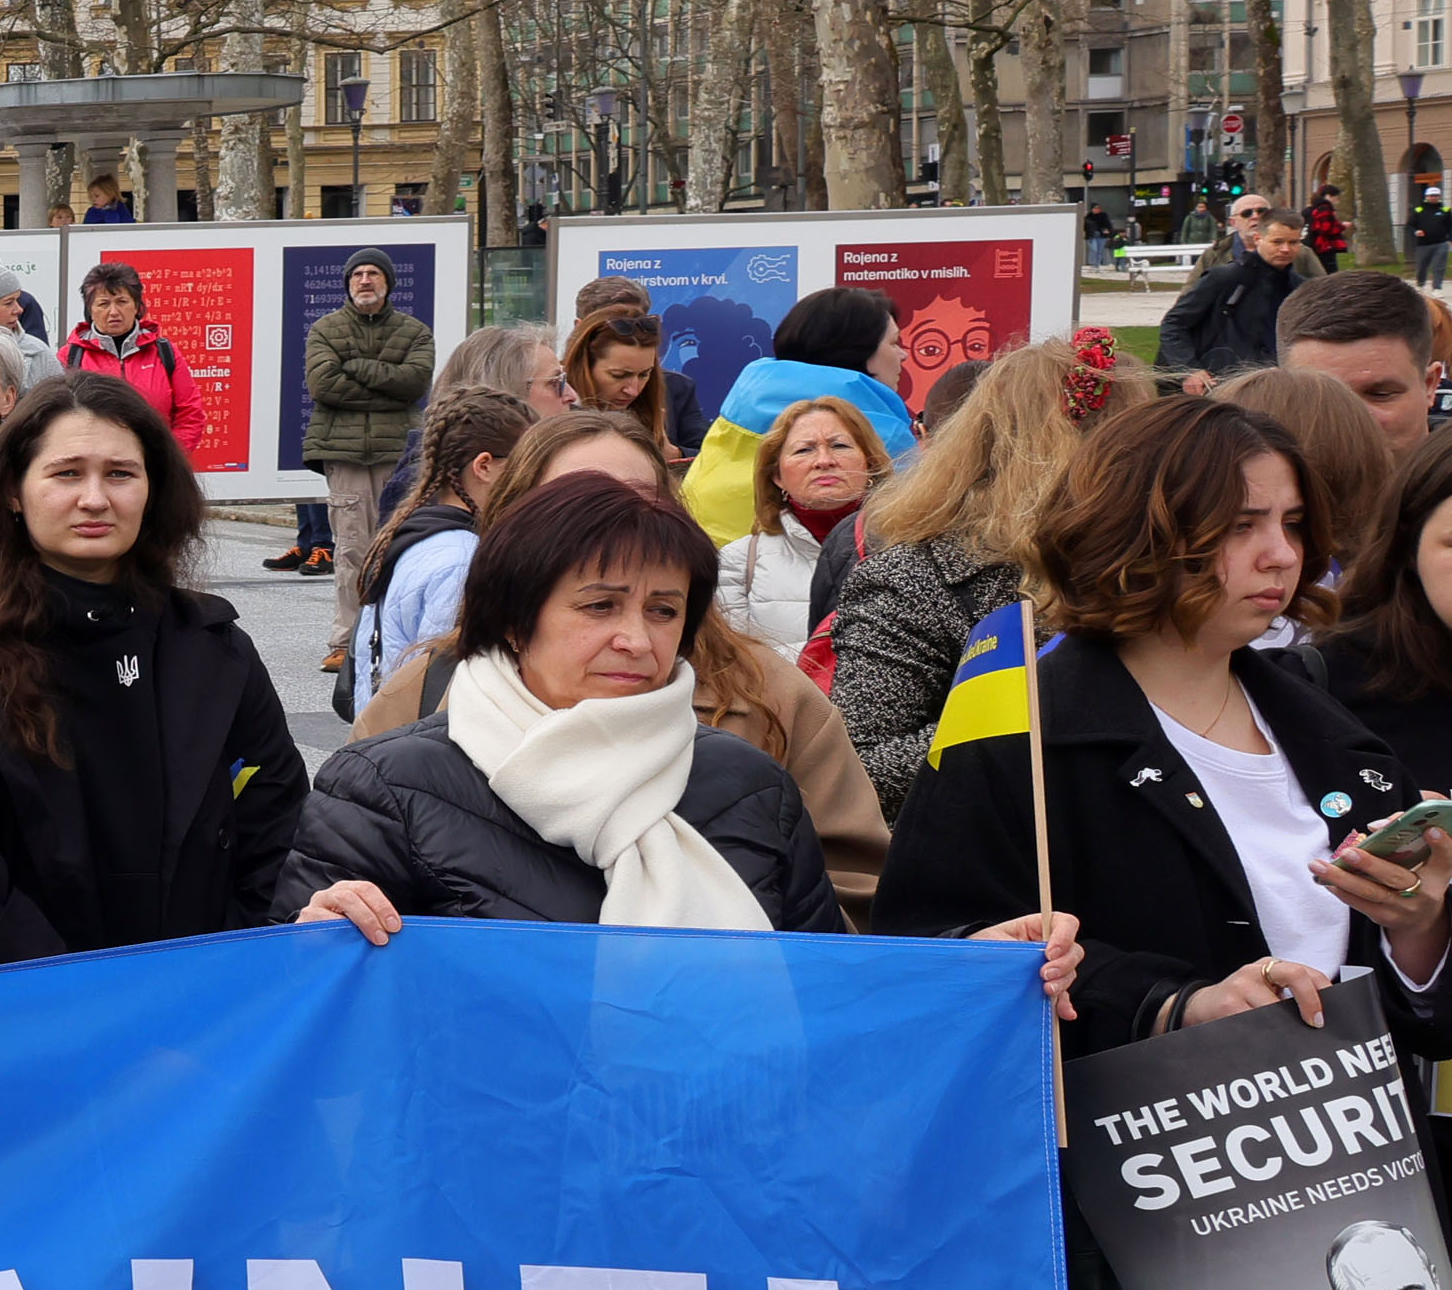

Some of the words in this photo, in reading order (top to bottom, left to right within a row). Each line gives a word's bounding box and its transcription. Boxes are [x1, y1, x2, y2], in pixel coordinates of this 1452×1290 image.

[606, 258, 652, 272] Rojena
[654, 259, 661, 269] z
[844, 251, 888, 266] Rojena
[891, 253, 898, 262] z
[691, 275, 700, 285] v
[701, 273, 729, 285] krvi.
[844, 267, 919, 281] matematiko
[921, 269, 929, 279] v
[931, 266, 971, 278] mislih.
[1094, 1098, 1189, 1146] THE
[1186, 1058, 1335, 1121] WORLD
[1190, 1190, 1306, 1237] UKRAINE
[1306, 1167, 1384, 1206] NEEDS
